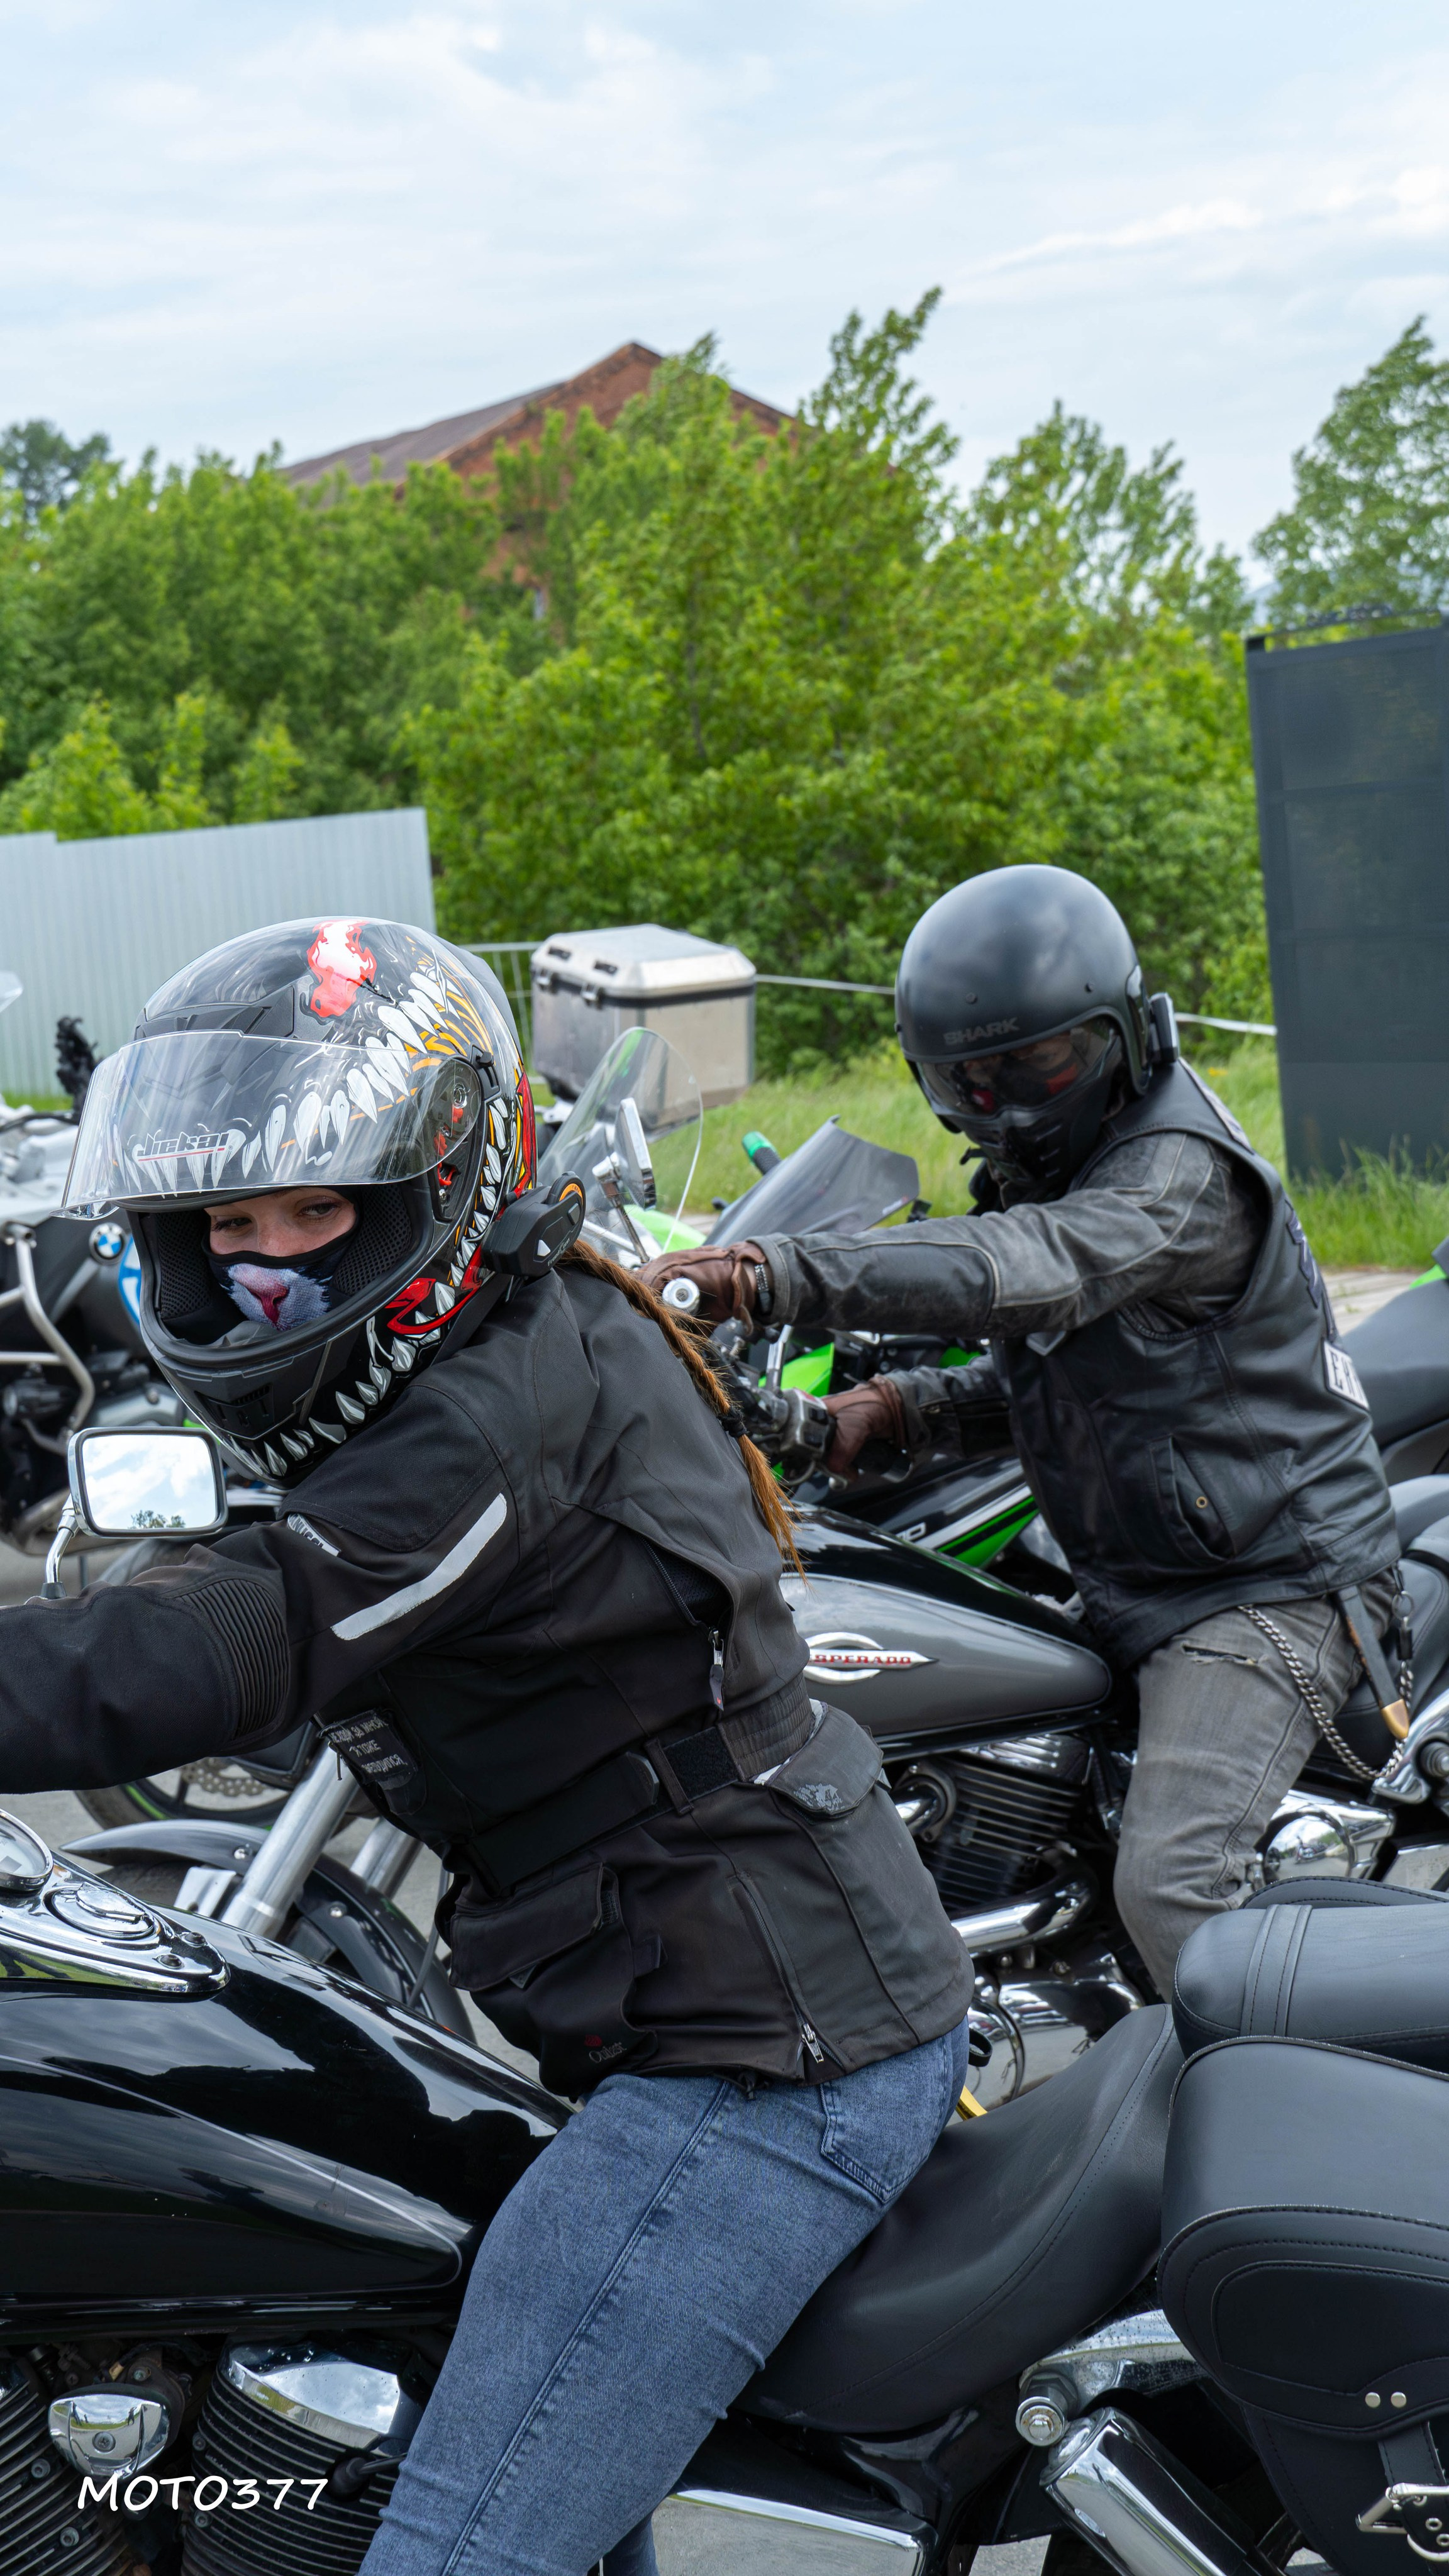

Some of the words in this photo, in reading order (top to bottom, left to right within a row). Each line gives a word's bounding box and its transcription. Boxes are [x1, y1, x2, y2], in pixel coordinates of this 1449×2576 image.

[943, 1017, 1019, 1046] SHARK
[809, 1655, 911, 1665] SPERADO
[357, 1740, 382, 1755] ТОЖЕ
